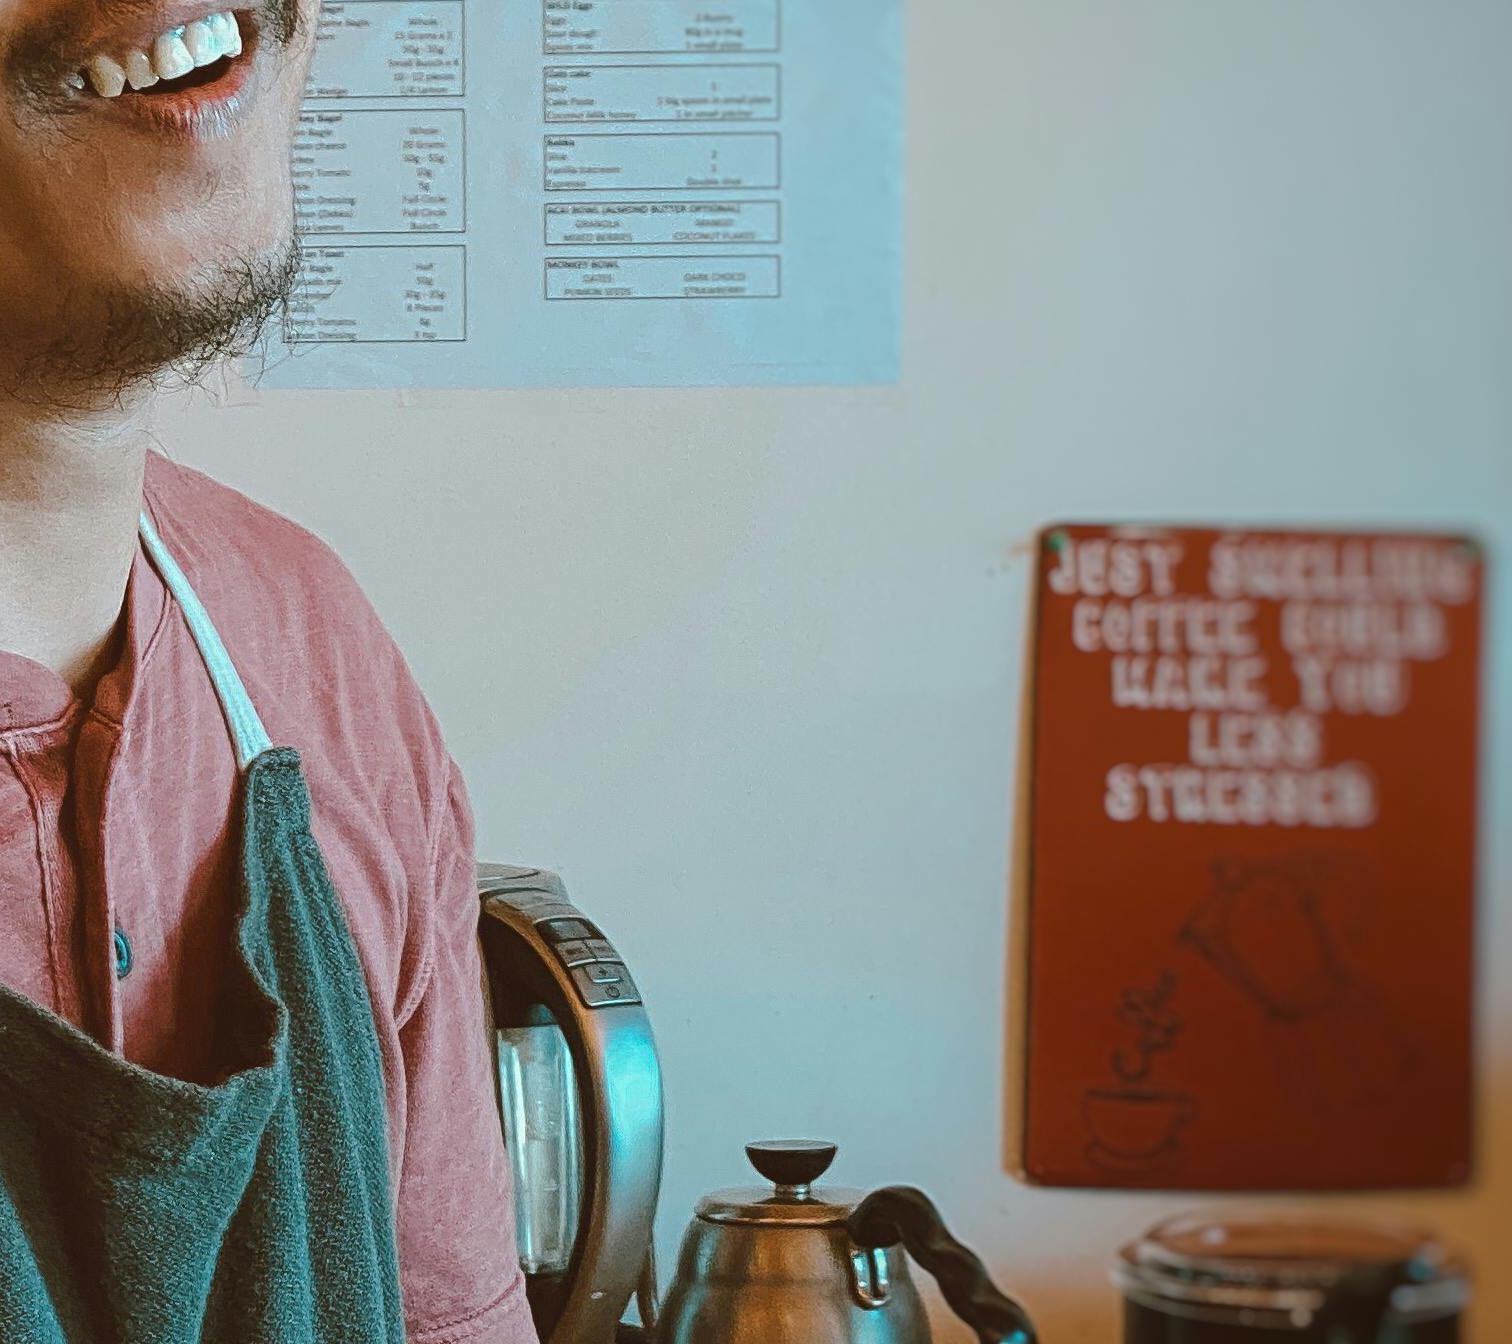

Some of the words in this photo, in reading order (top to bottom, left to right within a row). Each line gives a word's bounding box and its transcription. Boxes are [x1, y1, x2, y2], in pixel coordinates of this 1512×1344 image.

[1047, 538, 1183, 596] JUST
[1072, 600, 1258, 653] COFFEE
[1111, 655, 1268, 714] MAKE
[1292, 655, 1408, 715] YOU
[1188, 711, 1325, 768] LESS
[1103, 764, 1378, 828] STRESSED
